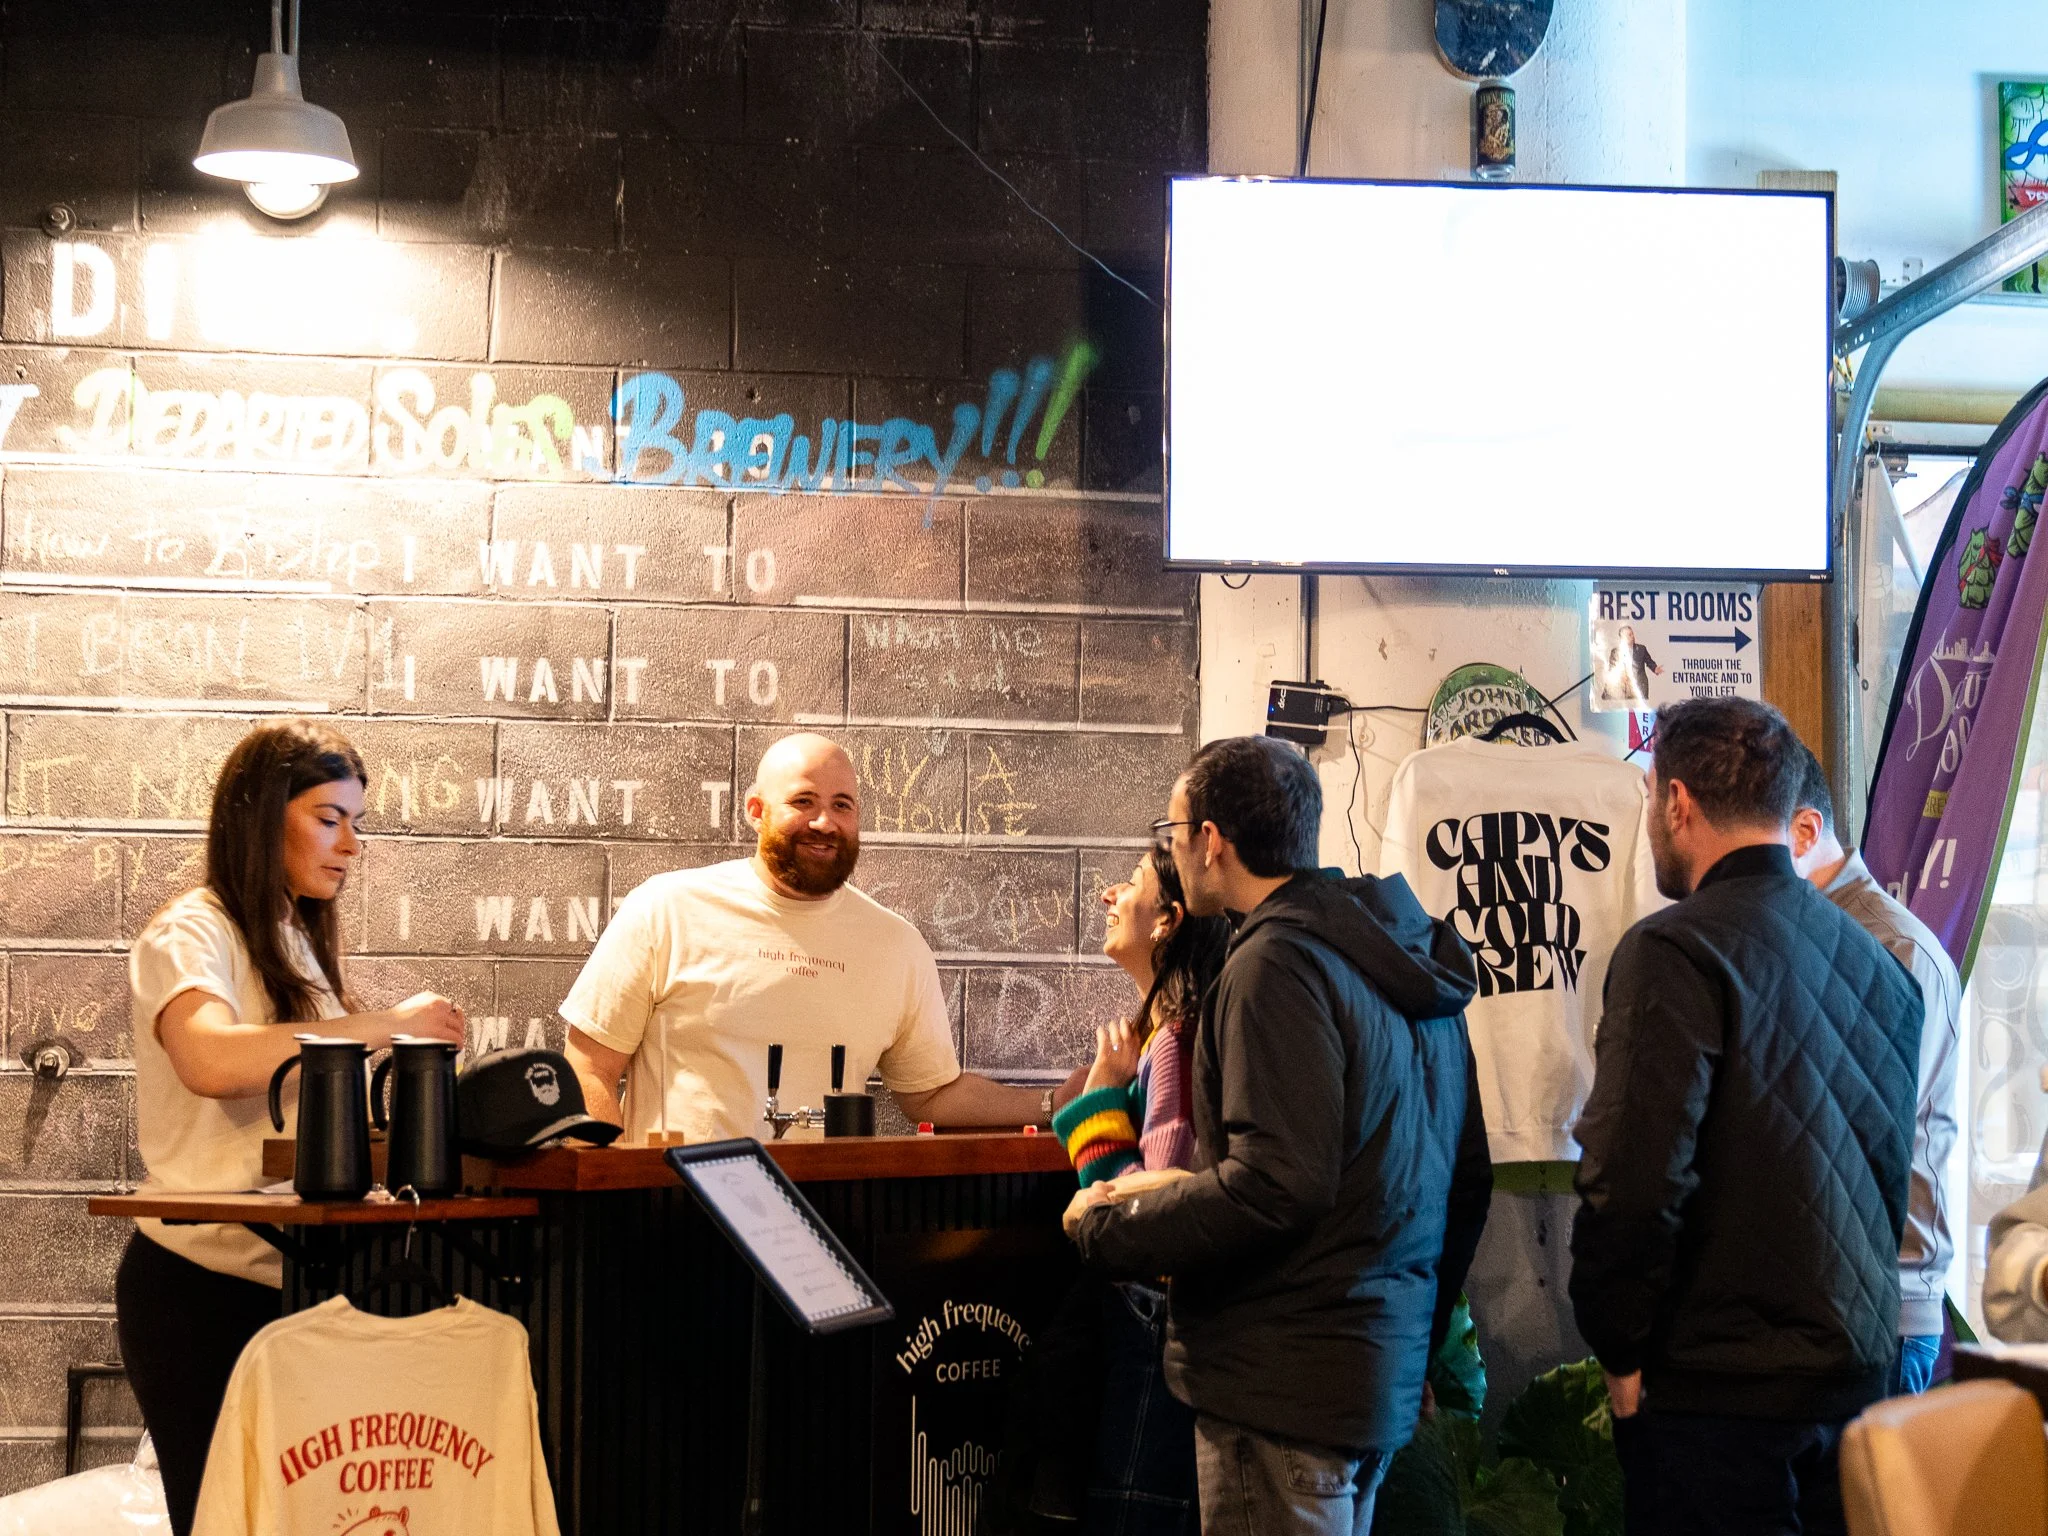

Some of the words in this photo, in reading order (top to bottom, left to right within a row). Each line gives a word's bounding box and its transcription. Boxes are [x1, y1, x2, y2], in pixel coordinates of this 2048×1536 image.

[402, 536, 416, 583] I
[478, 540, 645, 588] WANT
[704, 545, 776, 592] TO
[1599, 591, 1660, 621] REST
[1667, 592, 1752, 622] ROOMS
[480, 657, 647, 702] WANT
[708, 660, 779, 703] TO
[1672, 672, 1719, 684] ENTRANCE
[1721, 673, 1739, 684] AND
[1741, 673, 1752, 684] TO
[1682, 659, 1723, 670] THROUGH
[1726, 659, 1742, 670] THE
[1689, 686, 1713, 697] YOUR
[1715, 686, 1736, 697] LEFT
[474, 777, 643, 826] WANT
[1456, 855, 1563, 911] AND
[399, 896, 410, 942] I
[474, 896, 626, 943] WAN
[1444, 899, 1581, 954] COLD
[758, 947, 785, 961] high
[789, 951, 845, 972] frequency
[786, 963, 819, 978] coffee
[1474, 943, 1588, 998] REW
[896, 1316, 942, 1374] high
[943, 1299, 1034, 1362] frequenc
[936, 1358, 1001, 1383] COFFEE
[349, 1411, 495, 1479] FREQUENCY
[339, 1457, 435, 1494] COFFEE
